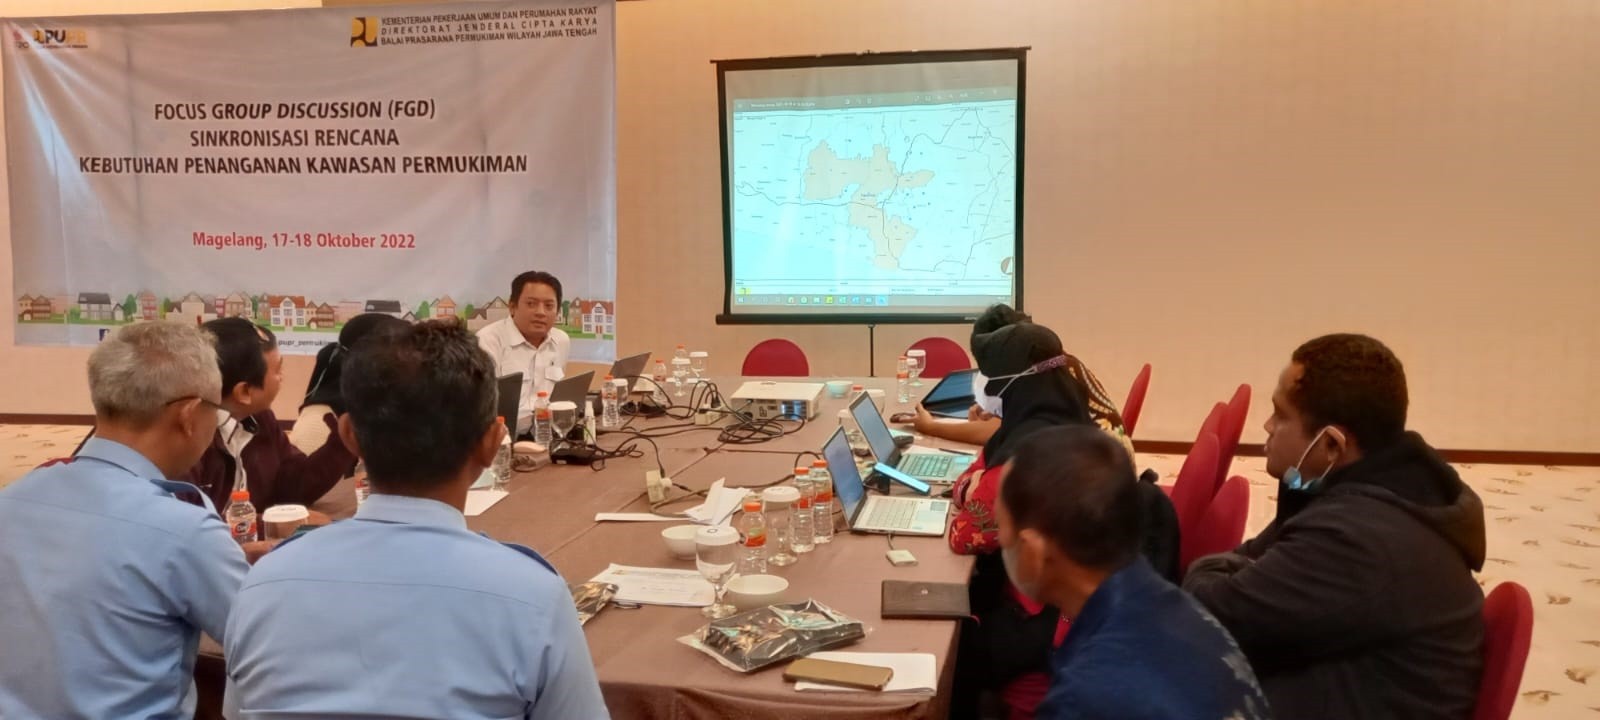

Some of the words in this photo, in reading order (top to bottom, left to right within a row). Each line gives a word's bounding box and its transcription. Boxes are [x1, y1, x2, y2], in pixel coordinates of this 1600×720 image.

[381, 16, 431, 26] KEMENTERIAN
[433, 14, 477, 23] PEKERJAAN
[478, 12, 501, 21] UMUM
[502, 11, 518, 19] DAN
[520, 9, 567, 19] PERUMAHAN
[568, 6, 598, 16] RAKYAT
[381, 24, 451, 36] DIREKTORAT
[457, 22, 516, 32] JENDERAL
[521, 19, 555, 29] CIPTA
[560, 17, 598, 27] KARYA
[381, 36, 404, 46] BALAI
[405, 34, 454, 45] PRASARANA
[455, 32, 505, 43] PERMUKIMAN
[506, 31, 541, 41] WILAYAH
[542, 30, 564, 39] JAWA
[565, 28, 598, 38] TENGAH
[154, 103, 207, 120] FOCUS
[211, 102, 272, 120] GROUP
[276, 101, 381, 119] DISCUSSION
[388, 98, 435, 121] (FGD)
[190, 129, 309, 147] SINKRONISASI
[314, 128, 400, 146] RENCANA
[79, 156, 179, 174] KEBUTUHAN
[184, 157, 301, 174] PENANGANAN
[306, 156, 396, 174] KAWASAN
[402, 155, 527, 174] PERMUKIMAN
[192, 231, 267, 250] Magelang,
[272, 232, 312, 247] 17-18
[316, 232, 376, 248] Oktober
[380, 234, 416, 248] 2022
